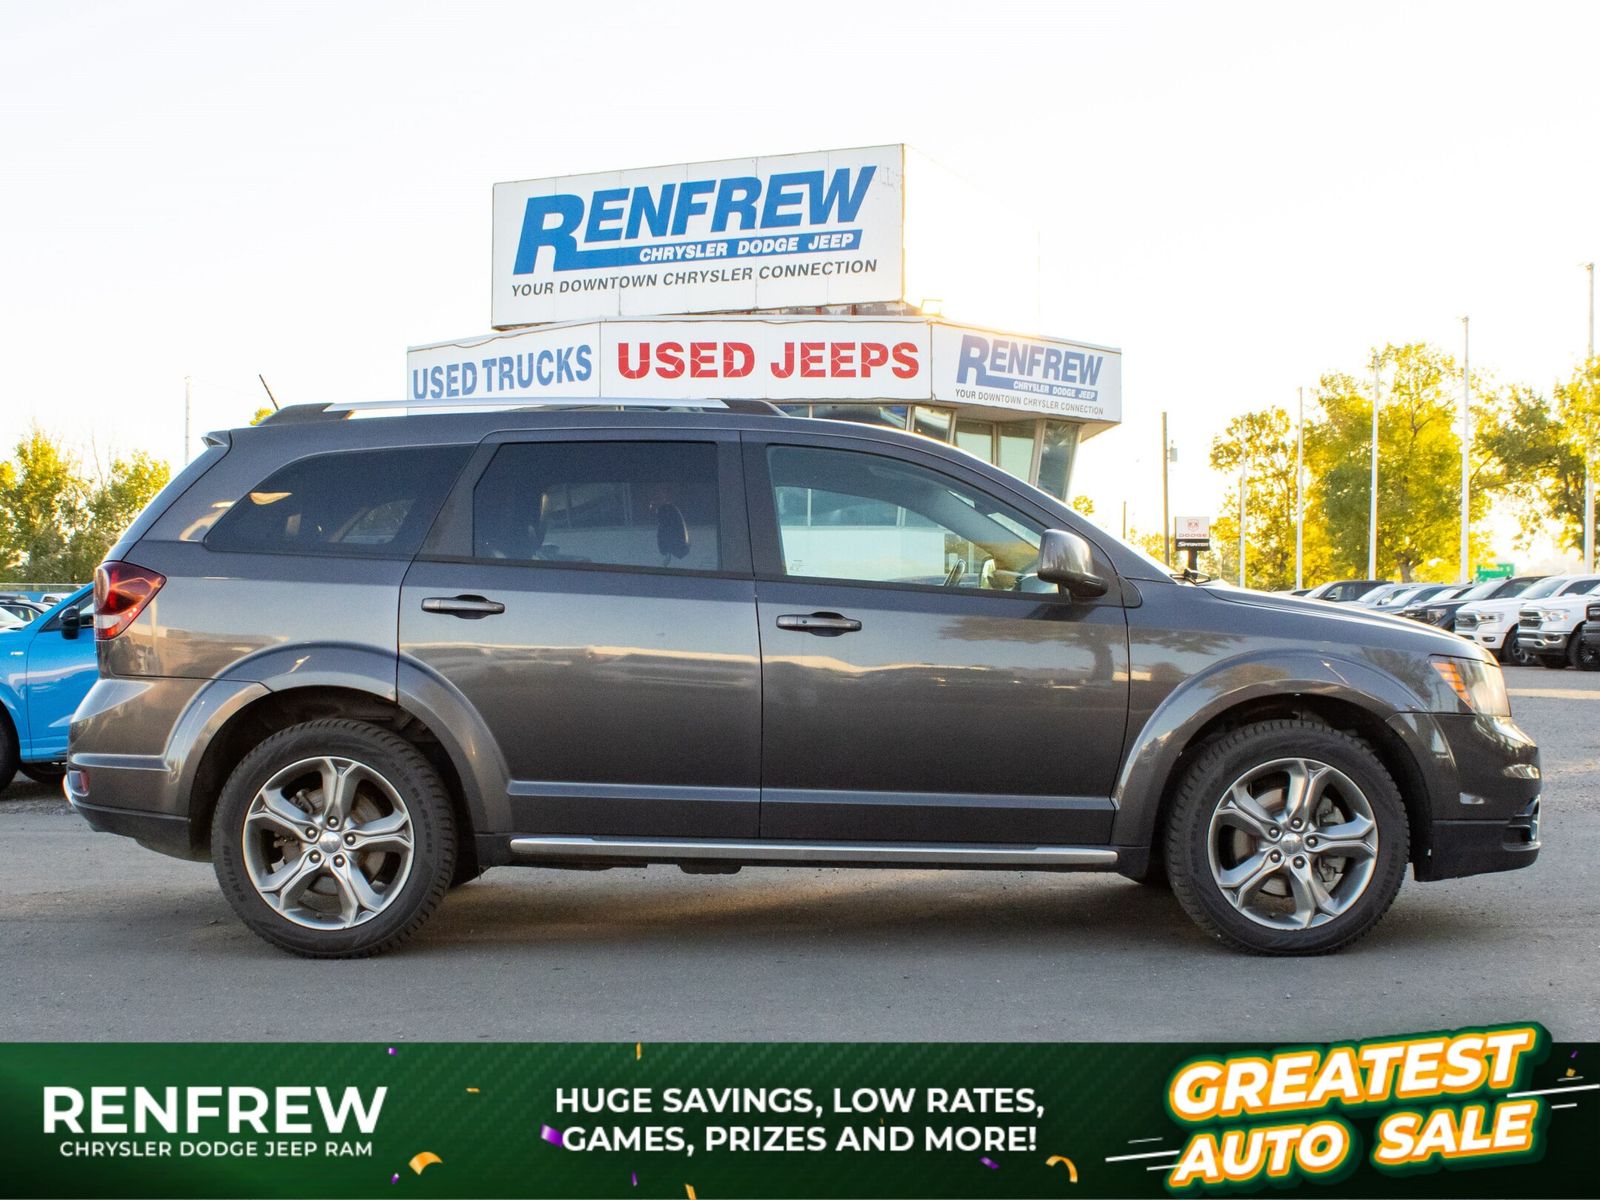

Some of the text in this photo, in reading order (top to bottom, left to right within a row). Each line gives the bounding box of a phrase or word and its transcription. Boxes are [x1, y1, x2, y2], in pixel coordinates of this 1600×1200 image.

[513, 165, 878, 275] RENFREW
[639, 233, 855, 262] CHRYSLER DODGE JEEP
[511, 259, 878, 298] YOUR DOWNTOWN CHRYSLER CONNECTION
[413, 344, 593, 399] USED TRUCKS
[617, 341, 920, 379] USED JEEPS
[956, 334, 1103, 386] RENFREW
[955, 388, 1104, 416] YOUR DOWNTOWN CHRYSLER CONNECTION
[1013, 381, 1096, 400] CHRYSLER DODGE JEEP
